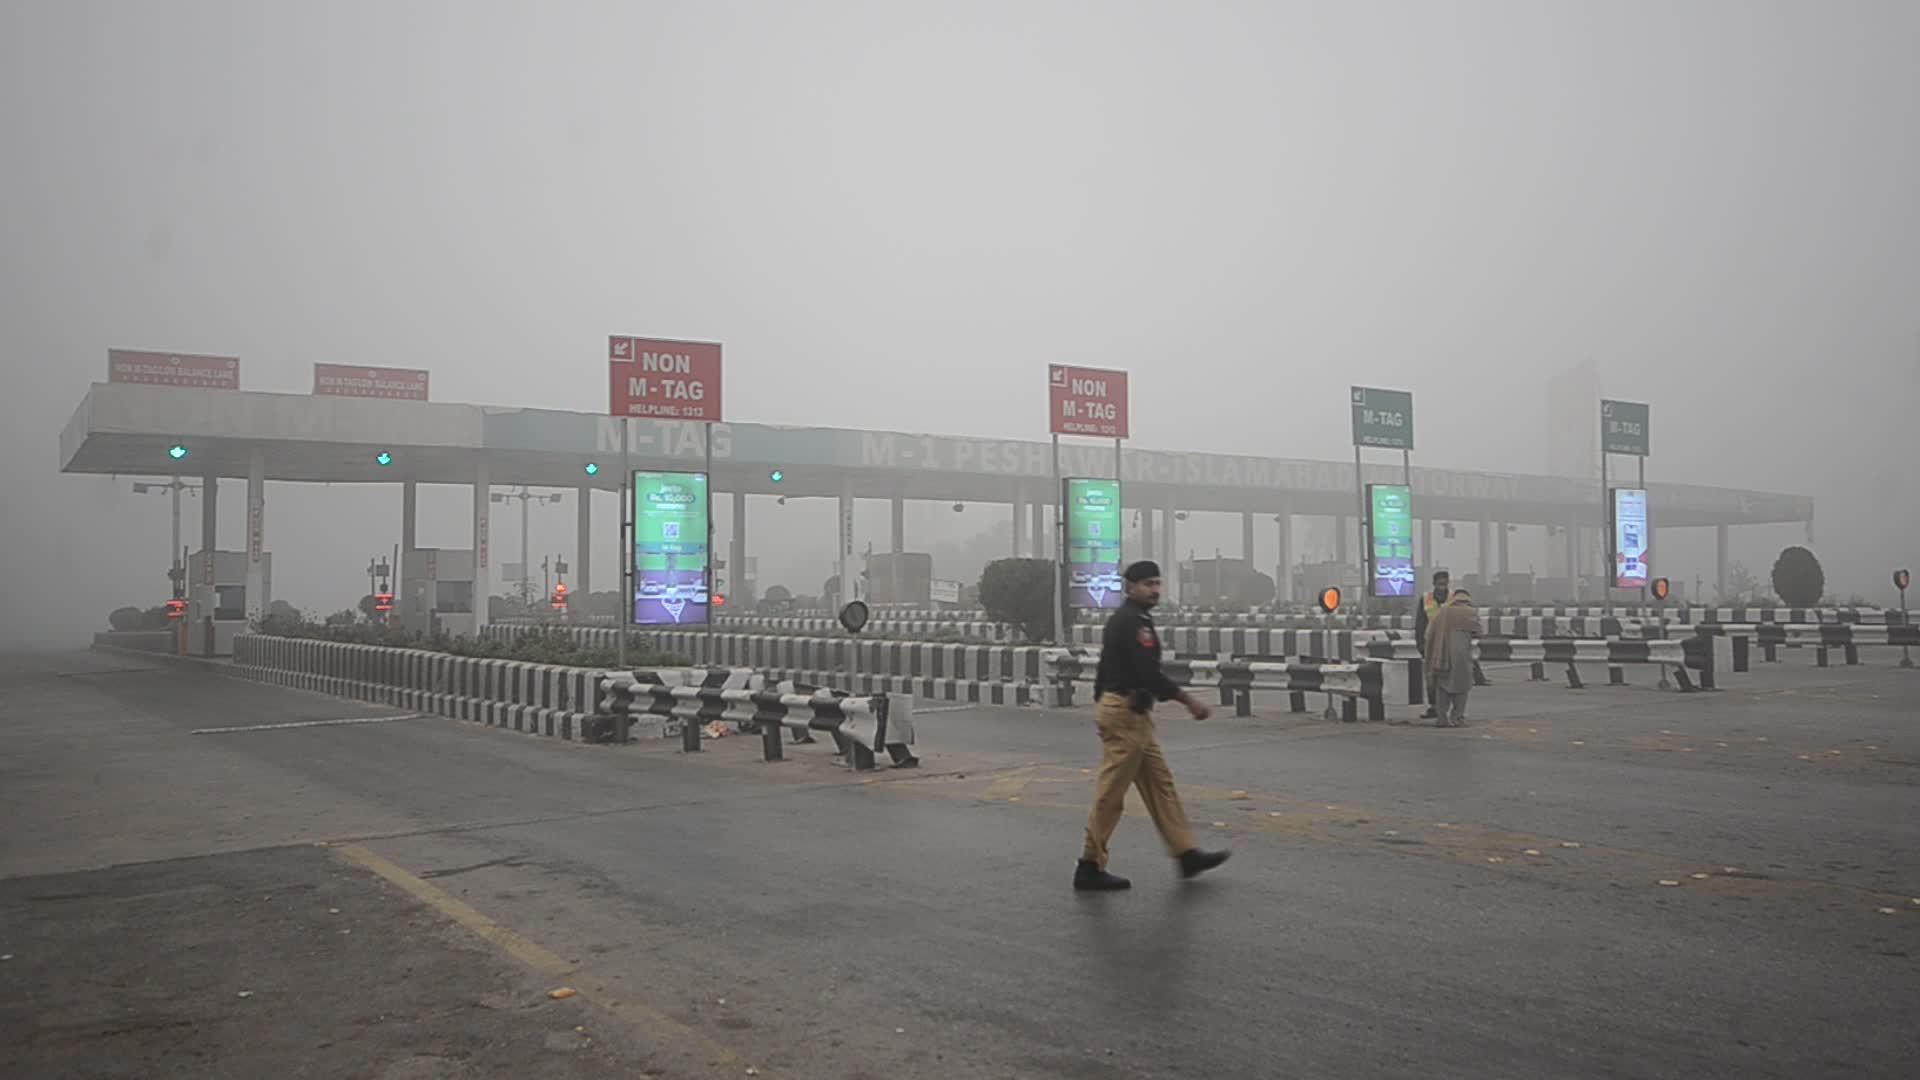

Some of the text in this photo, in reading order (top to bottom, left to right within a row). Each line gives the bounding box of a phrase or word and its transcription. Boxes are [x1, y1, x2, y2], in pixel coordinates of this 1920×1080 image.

[642, 352, 691, 373] NON
[1072, 378, 1107, 397] NON
[1363, 409, 1403, 427] M-TAG
[596, 417, 732, 457] M-TAG
[862, 432, 938, 470] M-1
